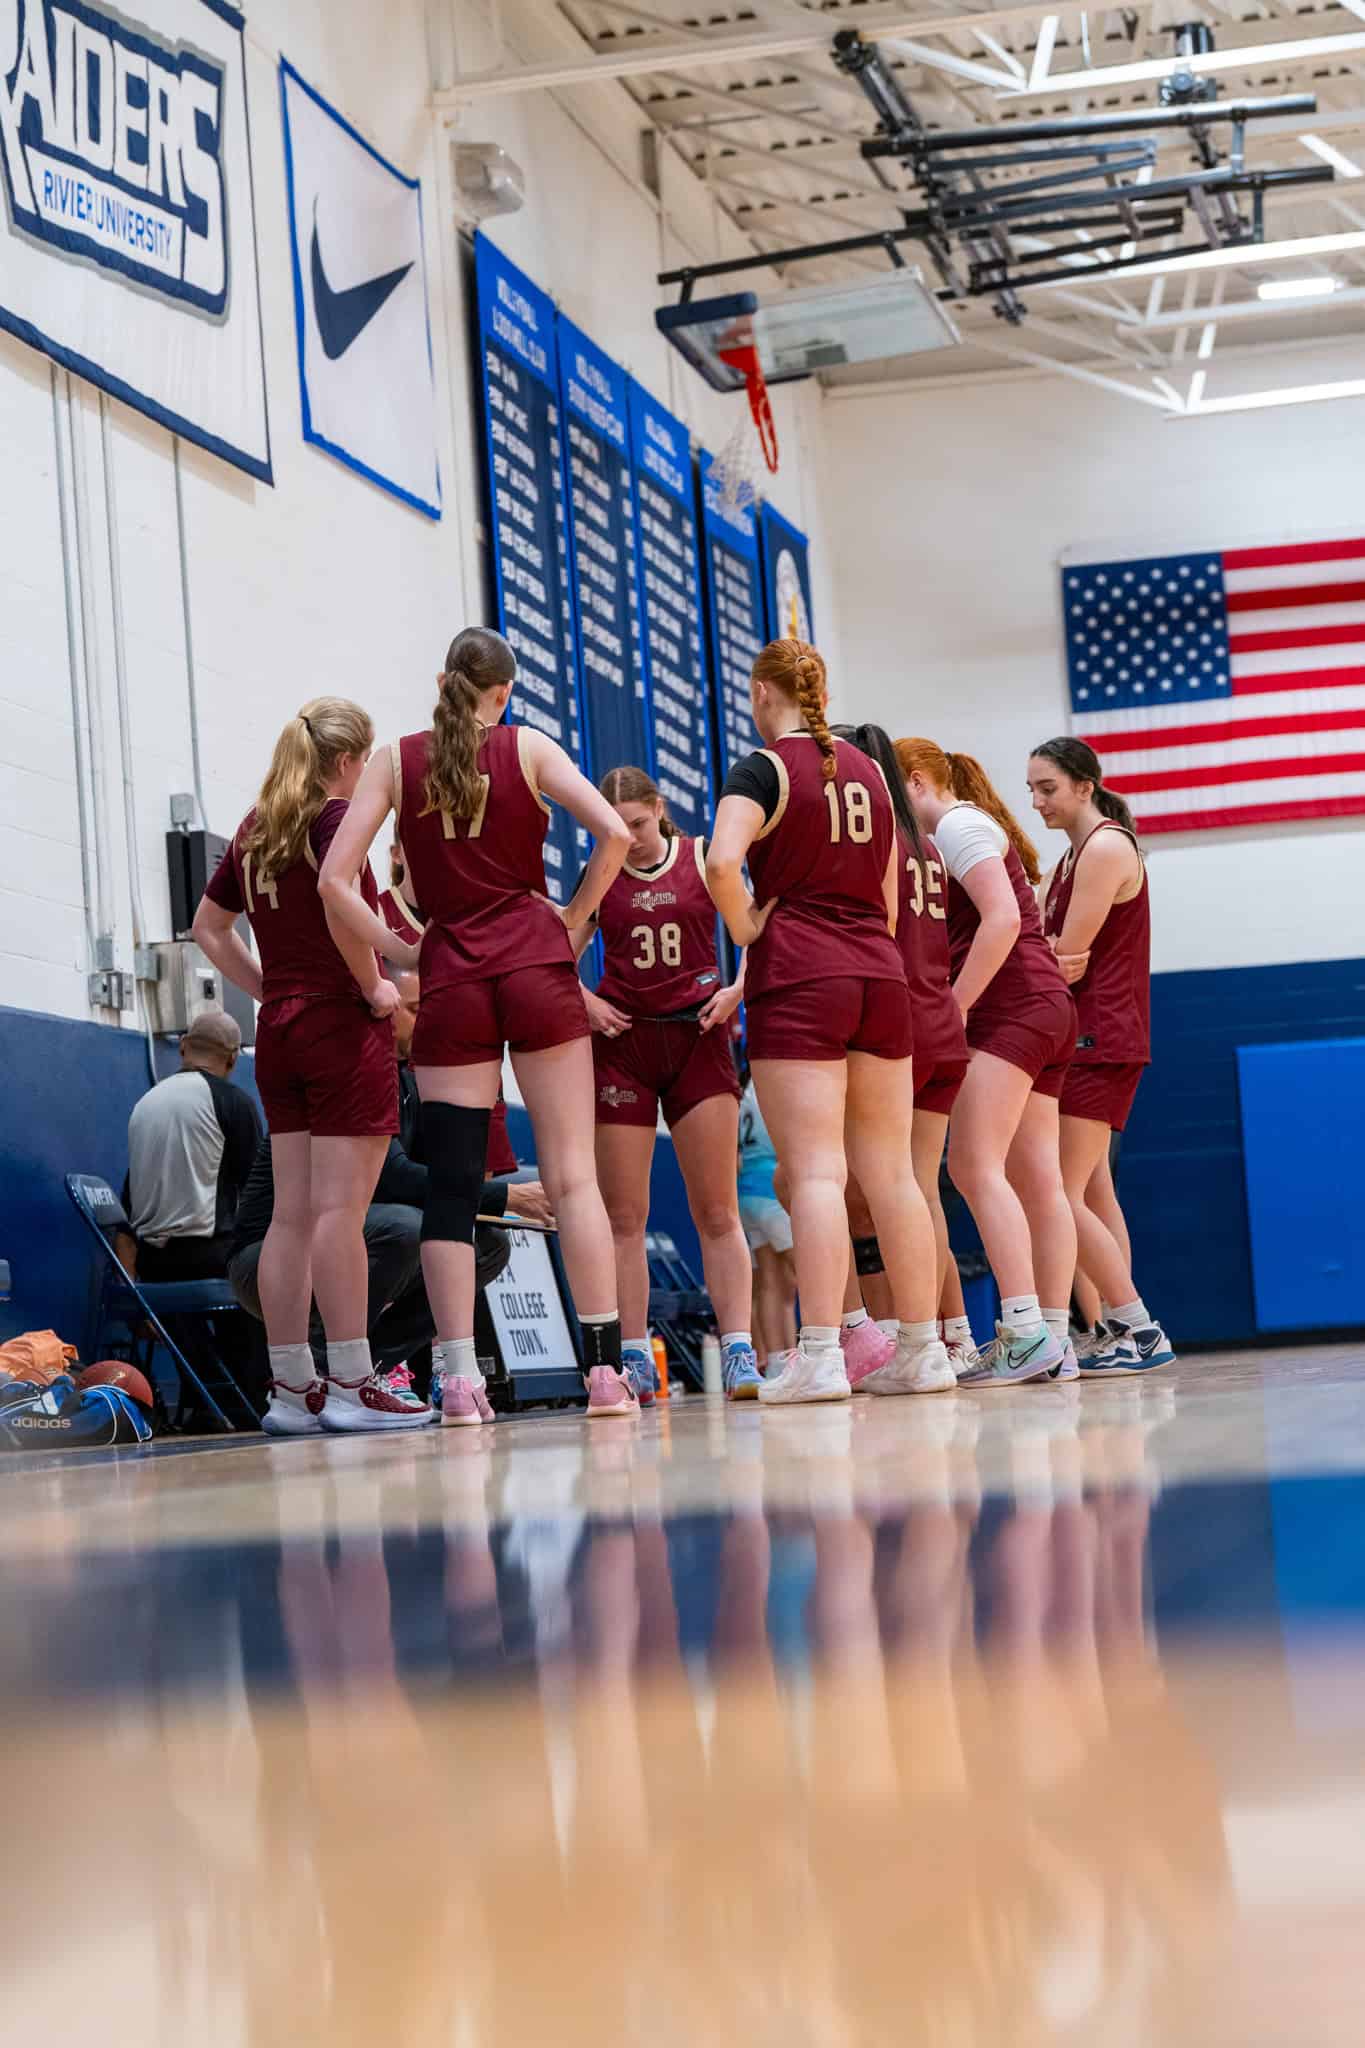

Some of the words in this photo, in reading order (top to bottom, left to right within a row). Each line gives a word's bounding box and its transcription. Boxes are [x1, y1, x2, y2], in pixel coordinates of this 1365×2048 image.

[43, 169, 93, 226] RIVIER
[95, 192, 173, 261] UNIVERSITY
[823, 781, 873, 844] 18
[241, 850, 280, 913] 14
[905, 856, 947, 920] 35
[631, 922, 682, 969] 38
[499, 1292, 549, 1320] COLLEGE
[508, 1329, 549, 1357] TOWN.
[11, 1415, 72, 1429] adidas
